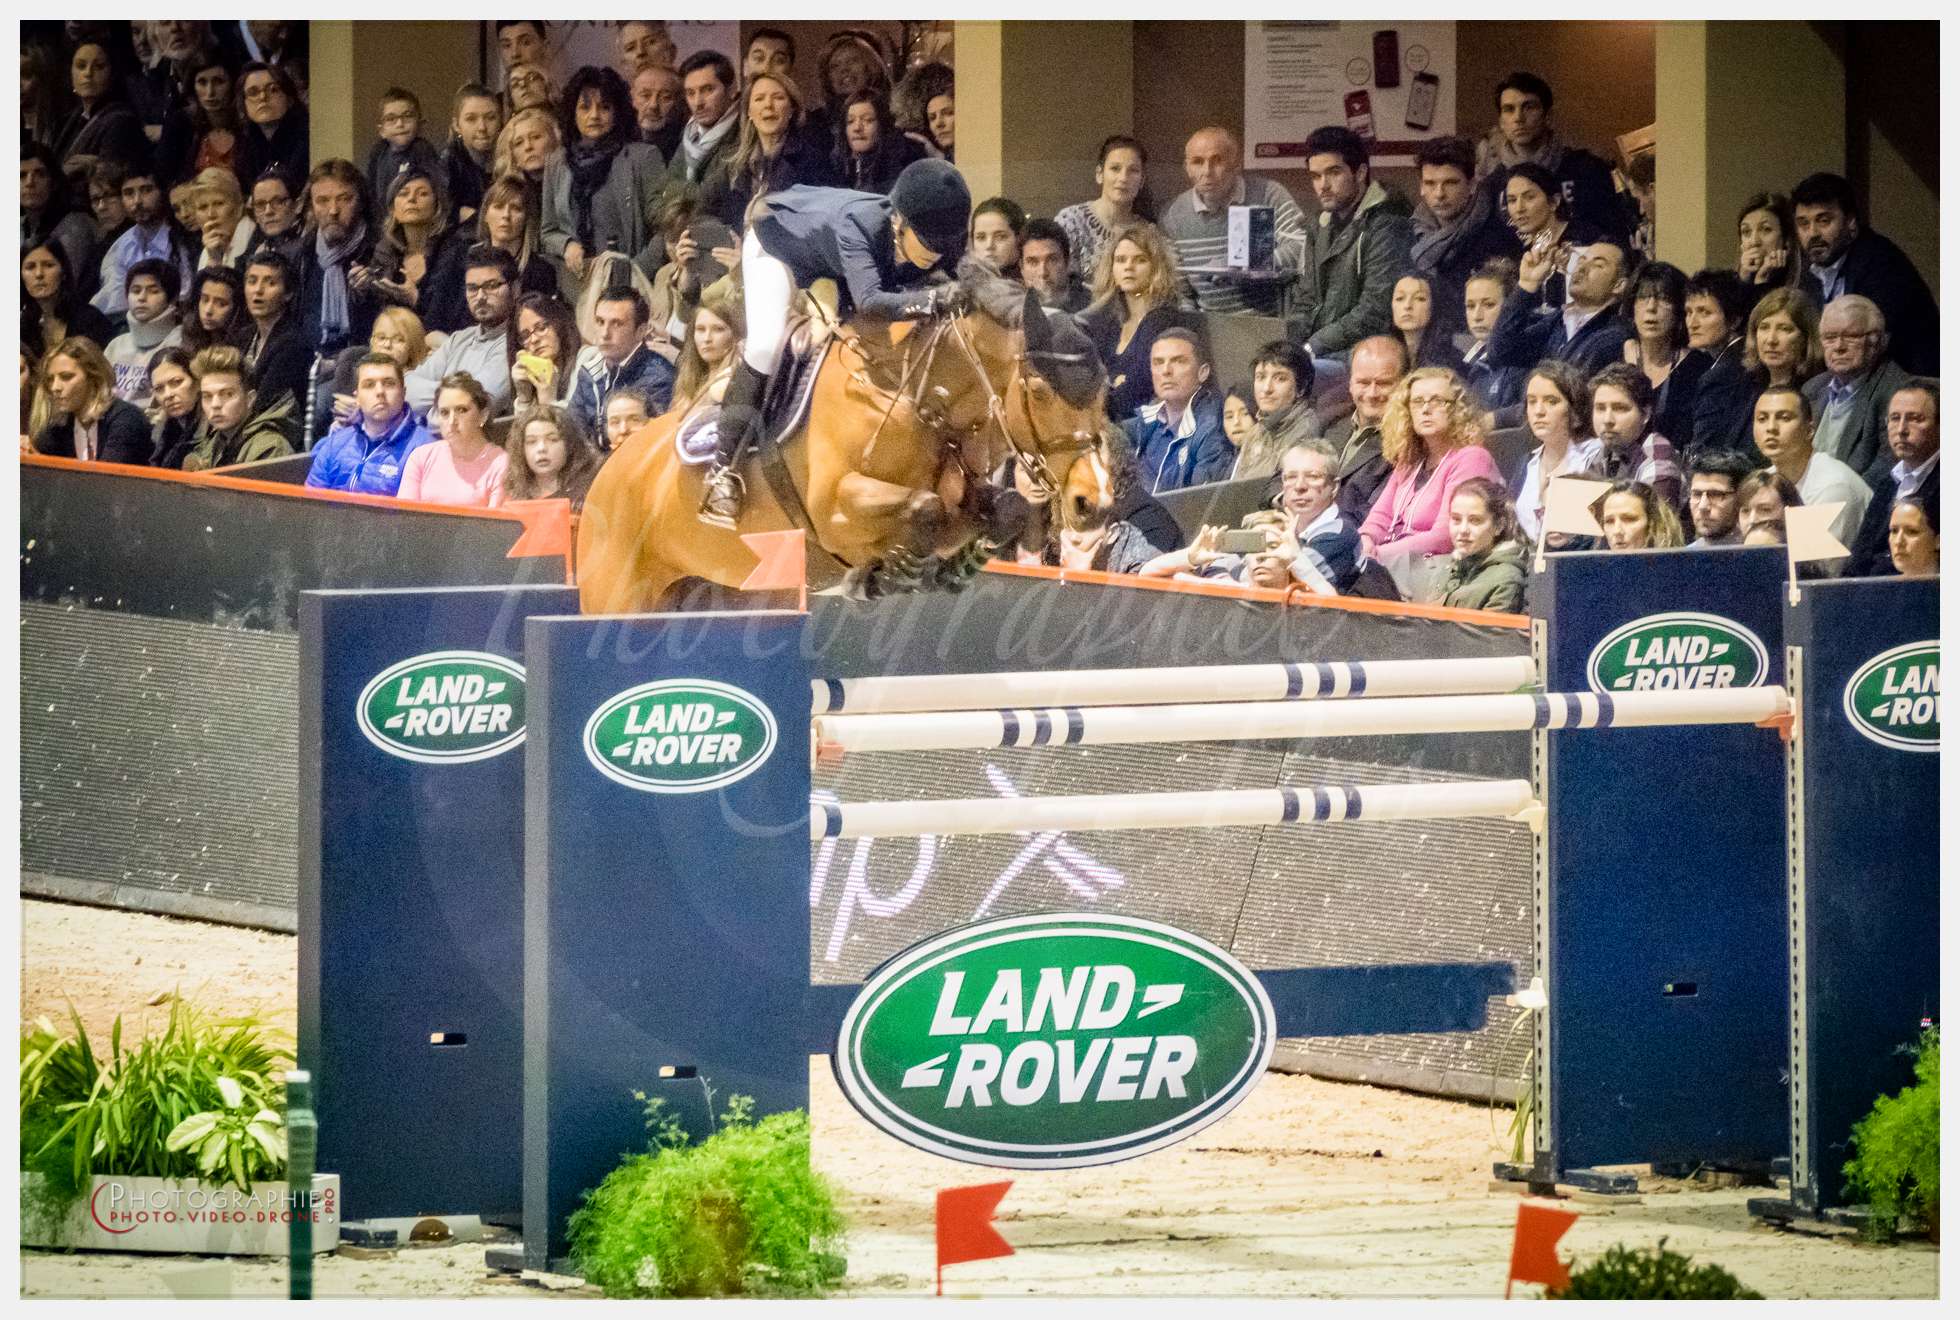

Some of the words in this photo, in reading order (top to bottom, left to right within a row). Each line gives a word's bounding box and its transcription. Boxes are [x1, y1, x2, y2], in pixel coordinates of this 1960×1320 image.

[1624, 635, 1710, 666] LAND
[396, 674, 485, 706] LAND
[1633, 664, 1736, 691] ROVER
[403, 703, 513, 737] ROVER
[624, 703, 714, 735] LAND
[1888, 695, 1940, 726] RO
[631, 733, 743, 766] ROVER
[928, 964, 1137, 1036] LAND
[944, 1034, 1199, 1109] ROVER
